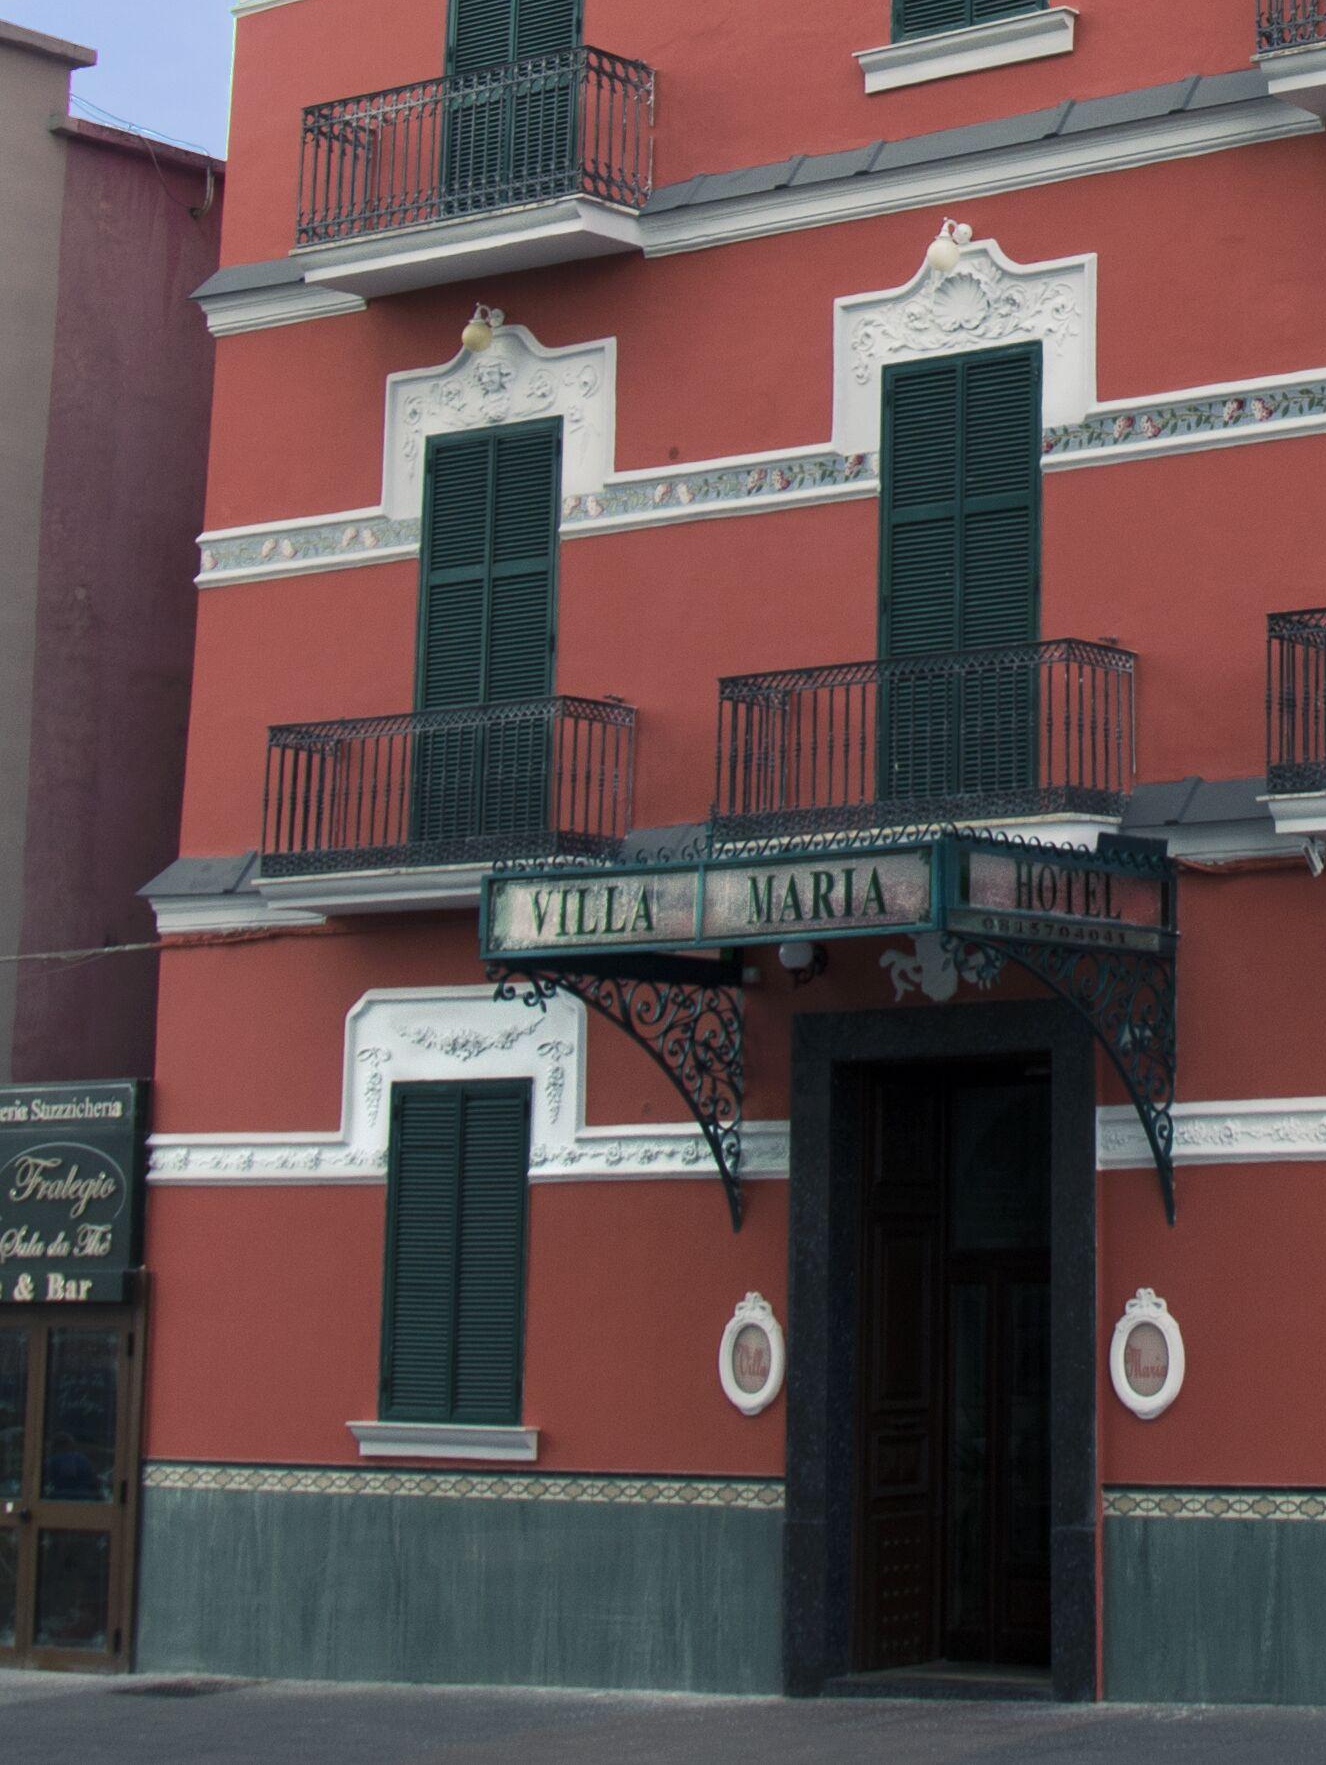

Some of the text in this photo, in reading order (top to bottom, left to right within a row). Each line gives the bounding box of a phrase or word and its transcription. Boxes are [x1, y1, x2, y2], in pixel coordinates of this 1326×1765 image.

[529, 867, 888, 936] VILLA MARIA
[1015, 858, 1122, 920] HOTEL
[30, 1096, 123, 1121] Stuzzicheria
[9, 1155, 116, 1219] Fralegio
[47, 1231, 70, 1257] da
[13, 1273, 35, 1301] &
[46, 1272, 92, 1301] Bar
